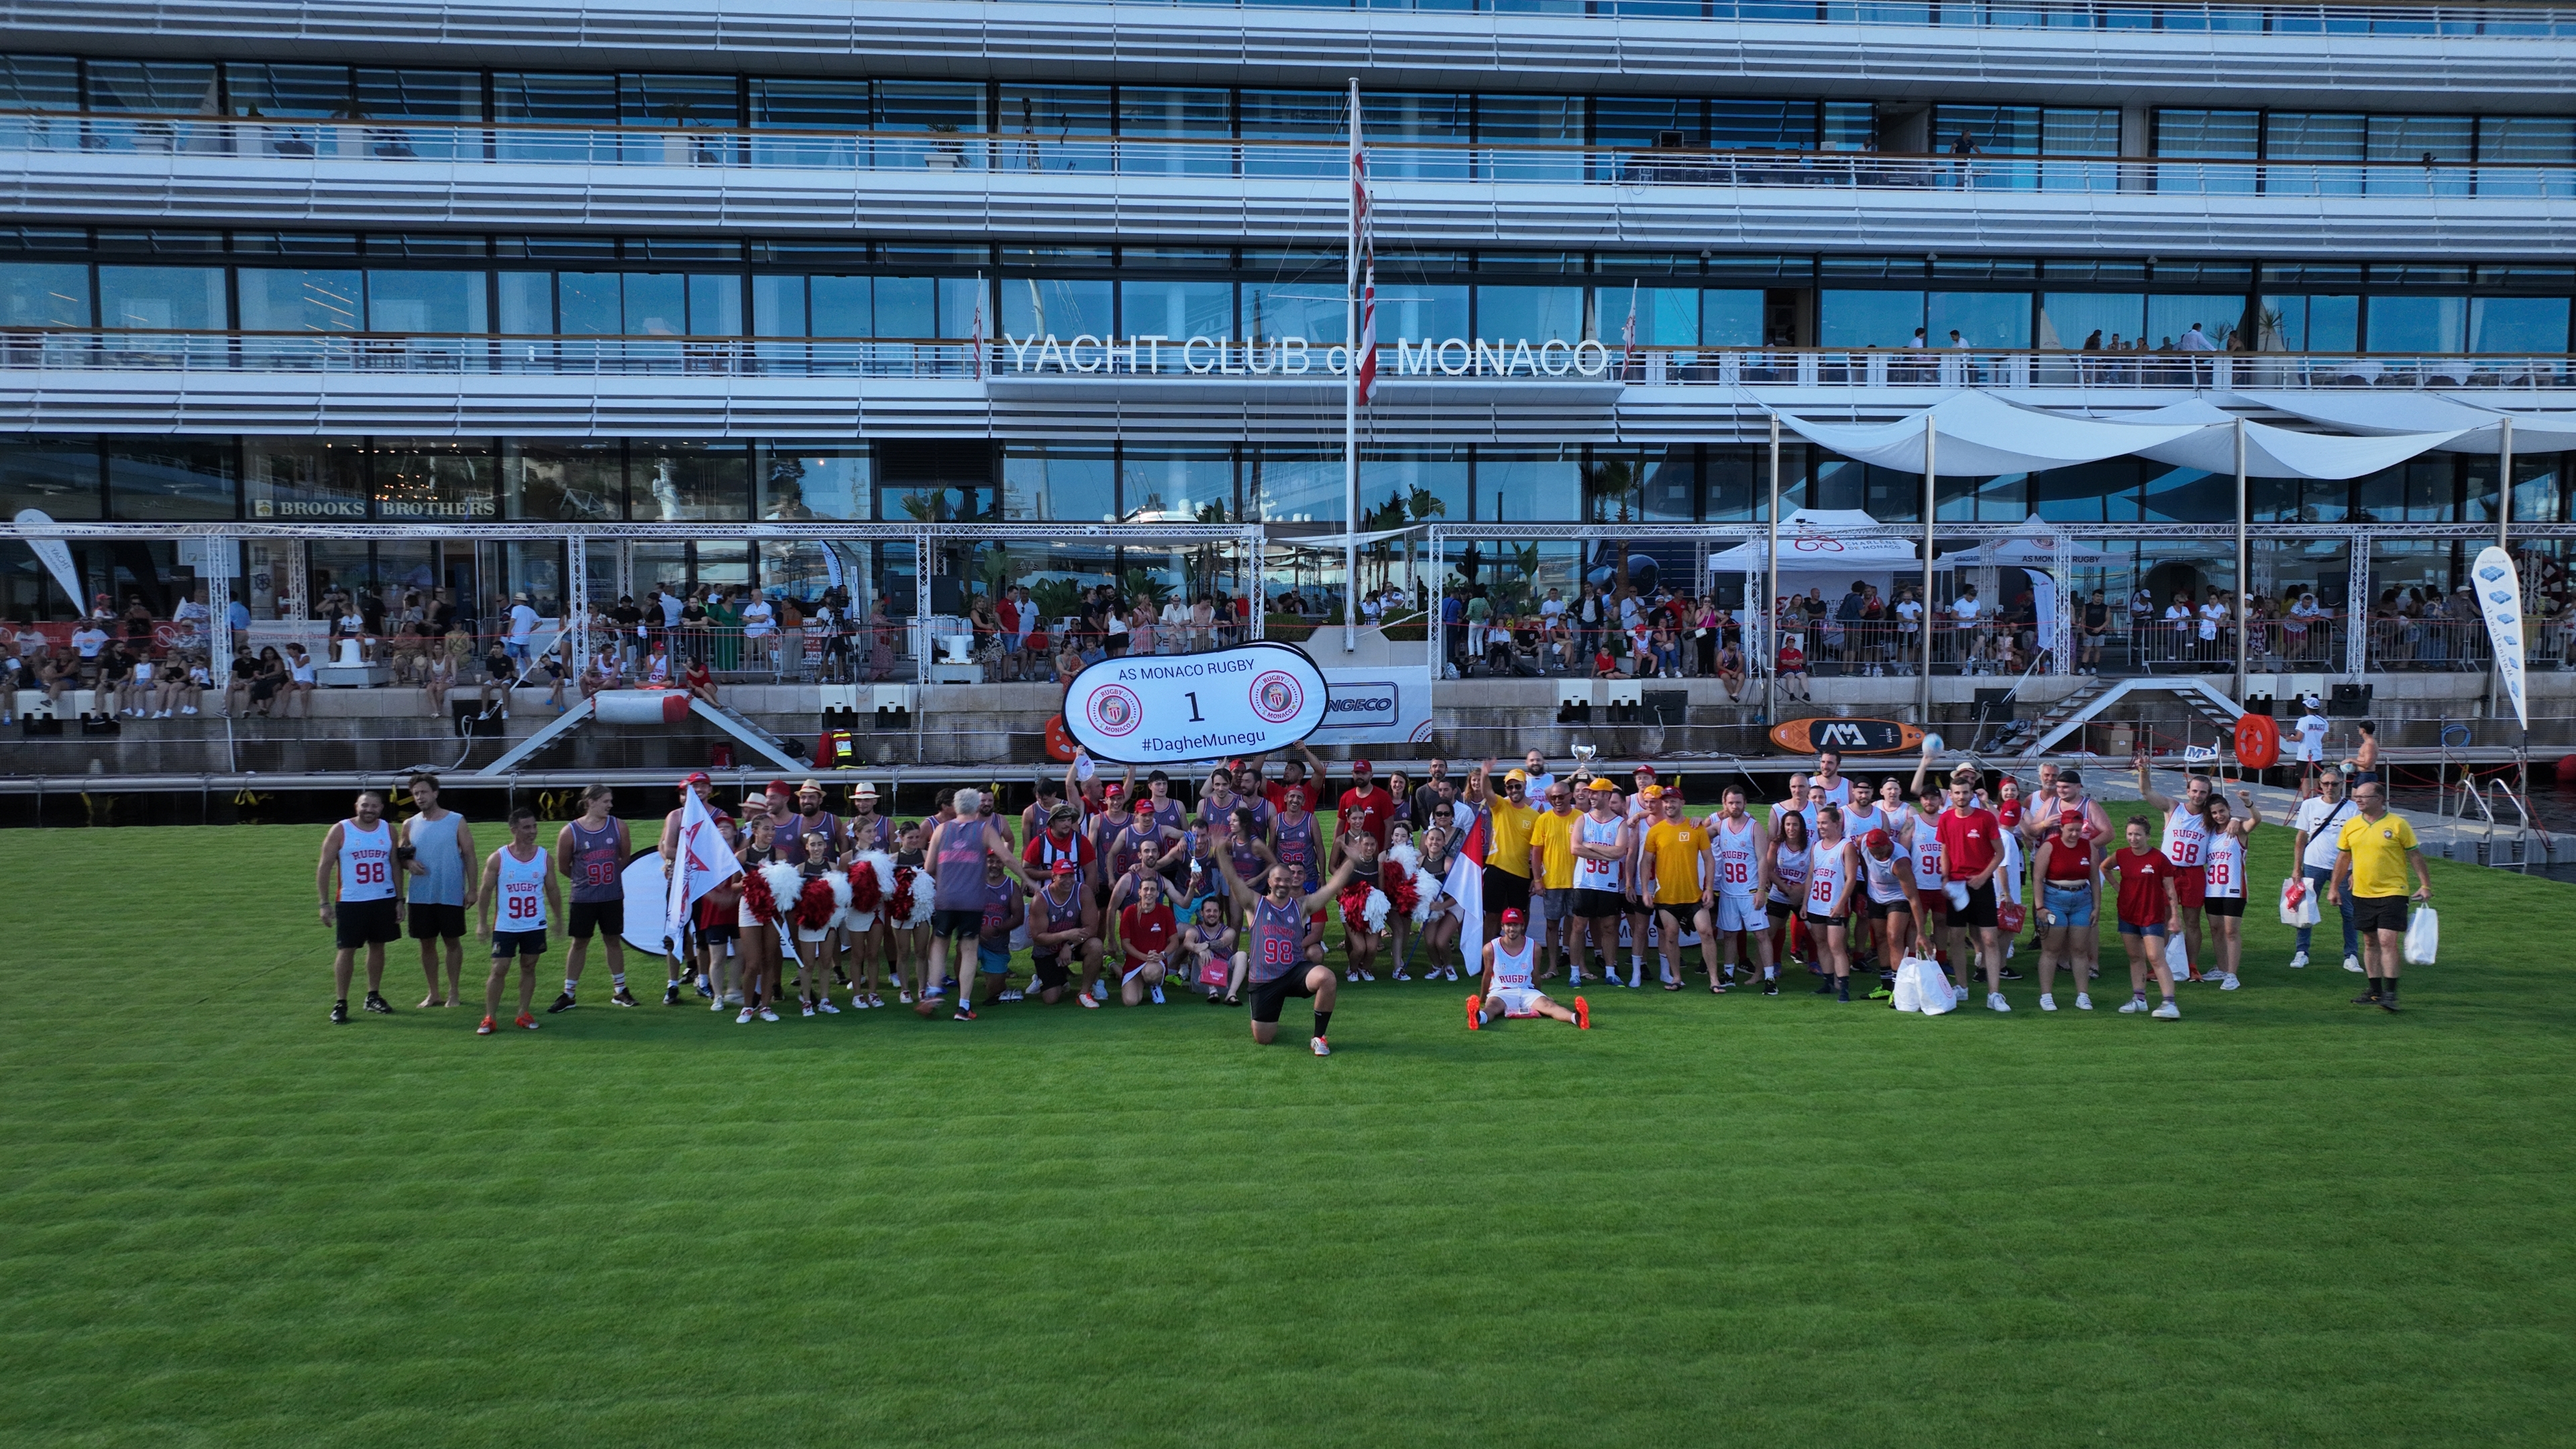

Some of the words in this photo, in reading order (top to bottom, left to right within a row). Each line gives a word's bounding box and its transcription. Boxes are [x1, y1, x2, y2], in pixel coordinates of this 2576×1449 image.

[1005, 333, 1168, 374] YACHT
[1183, 335, 1310, 374] CLUB
[1398, 337, 1607, 376] MONACO
[280, 502, 365, 515] BROOKS
[382, 502, 496, 516] BROTHERS
[2072, 555, 2101, 563] RUGBY
[1119, 669, 1136, 681] AS
[1141, 664, 1203, 680] MONACO
[1208, 659, 1254, 674] RUGBY
[1263, 675, 1285, 684] RUGBY
[1100, 688, 1124, 698] RUGBY
[1185, 692, 1205, 722] 1
[1328, 698, 1392, 712] NGECO
[1267, 708, 1293, 718] MONACO
[1104, 722, 1132, 733] MONACO
[1142, 731, 1266, 753] #DagheMunegu
[2172, 828, 2205, 842] RUGBY
[352, 849, 388, 860] RUGBY
[1722, 850, 1749, 860] RUGBY
[2171, 841, 2200, 864] 98
[356, 862, 384, 884] 98
[587, 861, 615, 885] 98
[1725, 862, 1748, 883] 98
[506, 883, 539, 893] RUGBY
[508, 896, 537, 919] 98
[1263, 926, 1295, 940] RUGBY
[1264, 938, 1293, 964] 98
